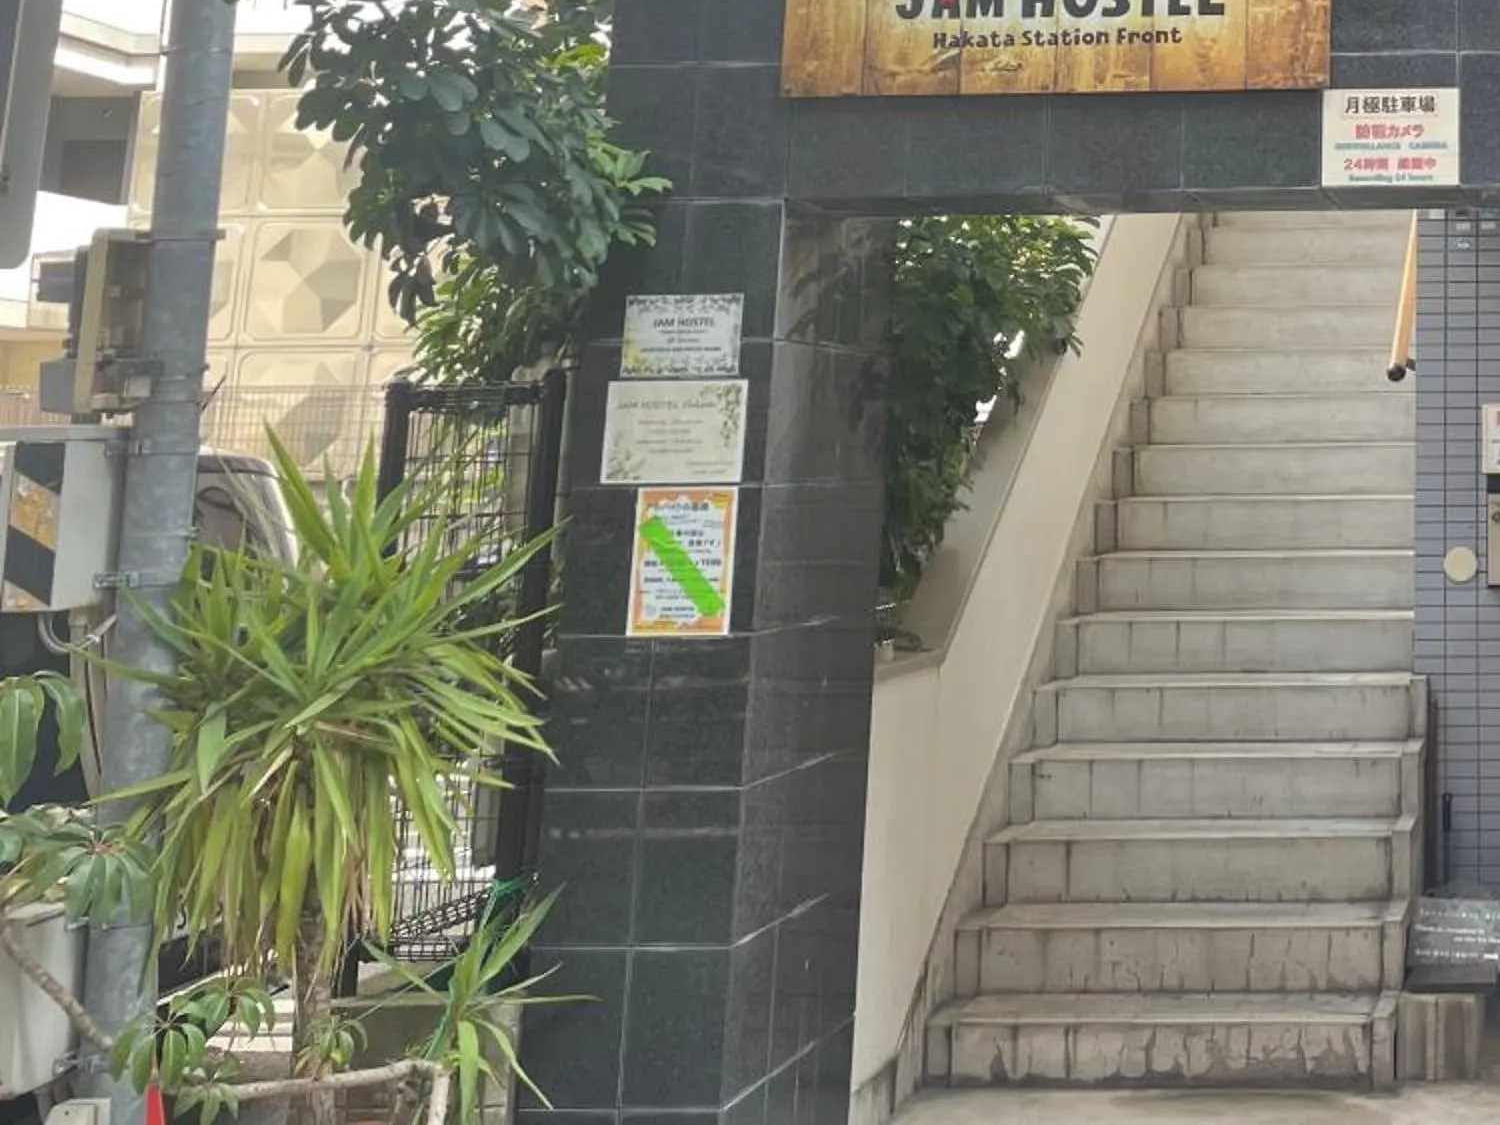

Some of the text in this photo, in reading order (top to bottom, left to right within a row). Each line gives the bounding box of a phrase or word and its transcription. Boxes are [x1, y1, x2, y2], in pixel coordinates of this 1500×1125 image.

[932, 27, 1183, 49] Hakata Station Front
[1345, 95, 1436, 114] 月極駐車場
